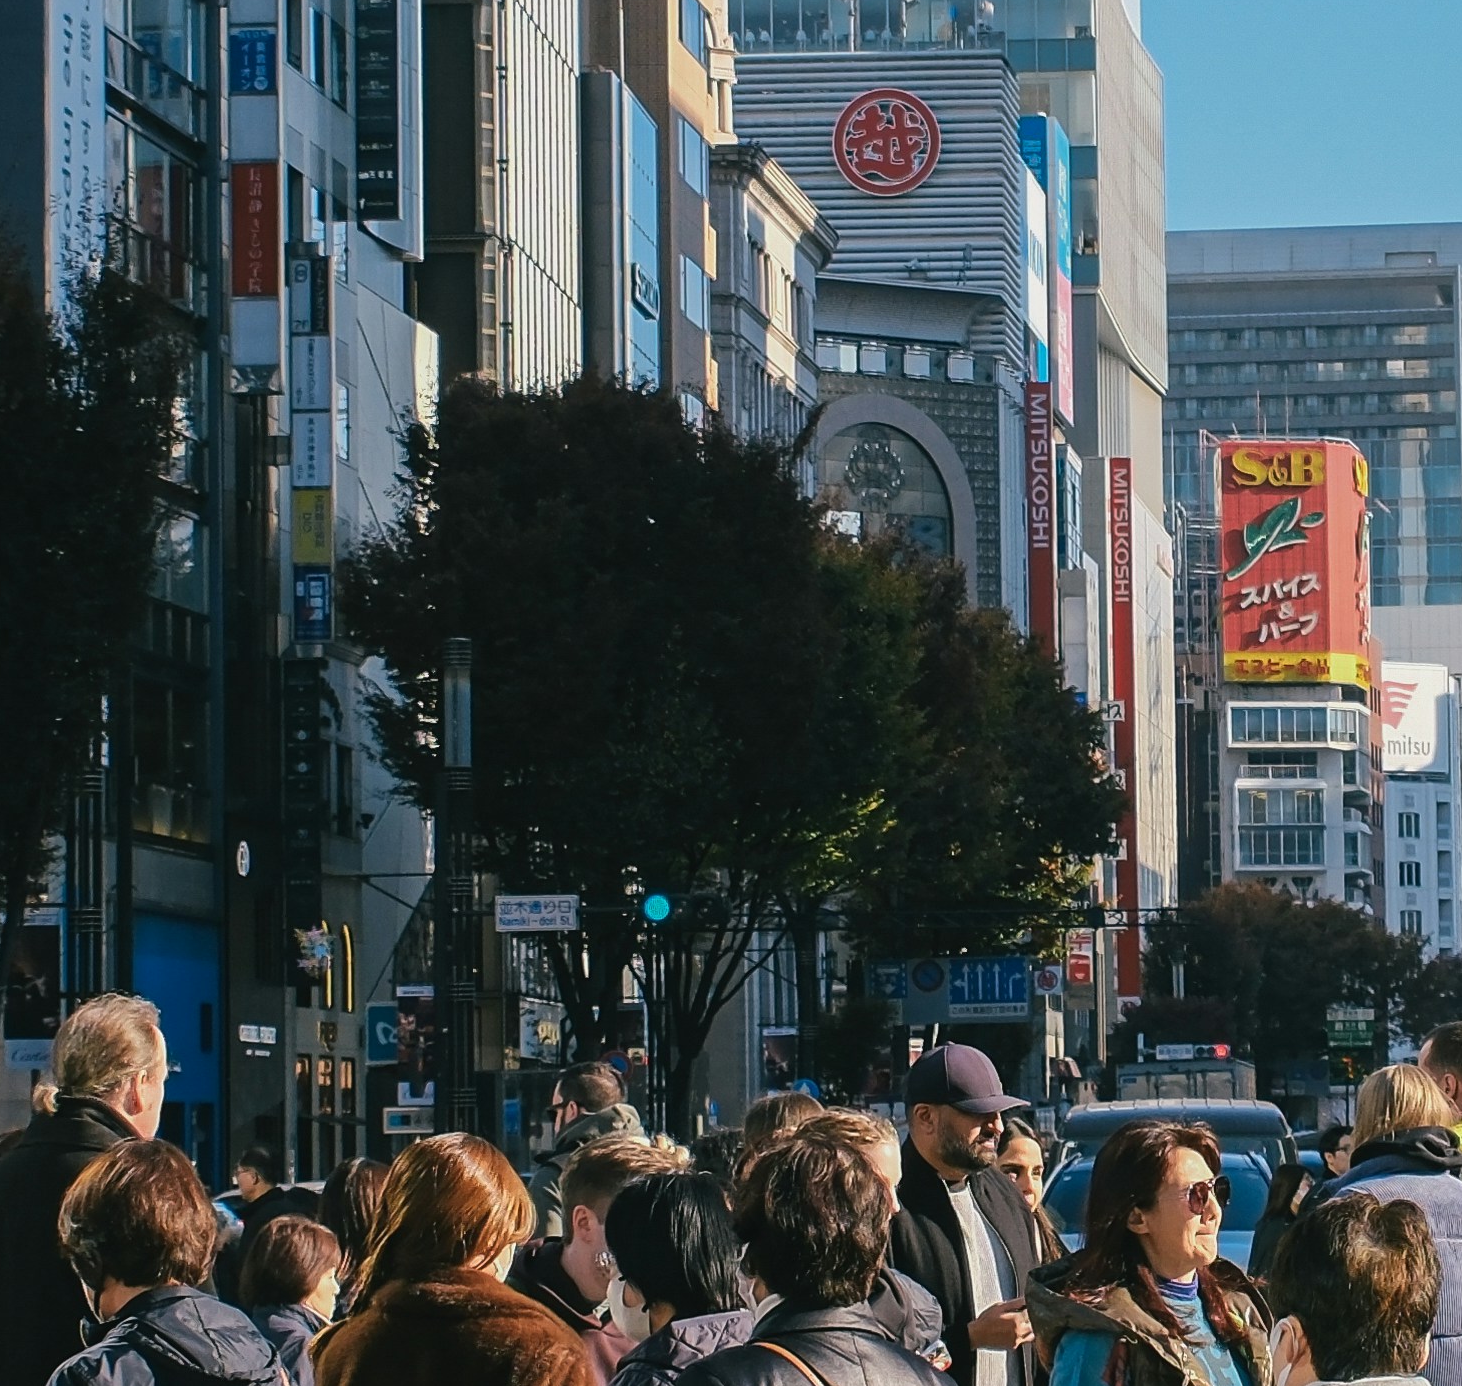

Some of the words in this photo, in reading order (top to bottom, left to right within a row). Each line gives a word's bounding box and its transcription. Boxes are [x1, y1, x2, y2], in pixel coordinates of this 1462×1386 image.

[1030, 393, 1050, 549] MITSUKOSHI
[1231, 447, 1326, 487] S&B
[1113, 467, 1130, 603] MITSUKOSHI
[1240, 572, 1321, 609] スパイス
[1383, 734, 1431, 756] mitsu
